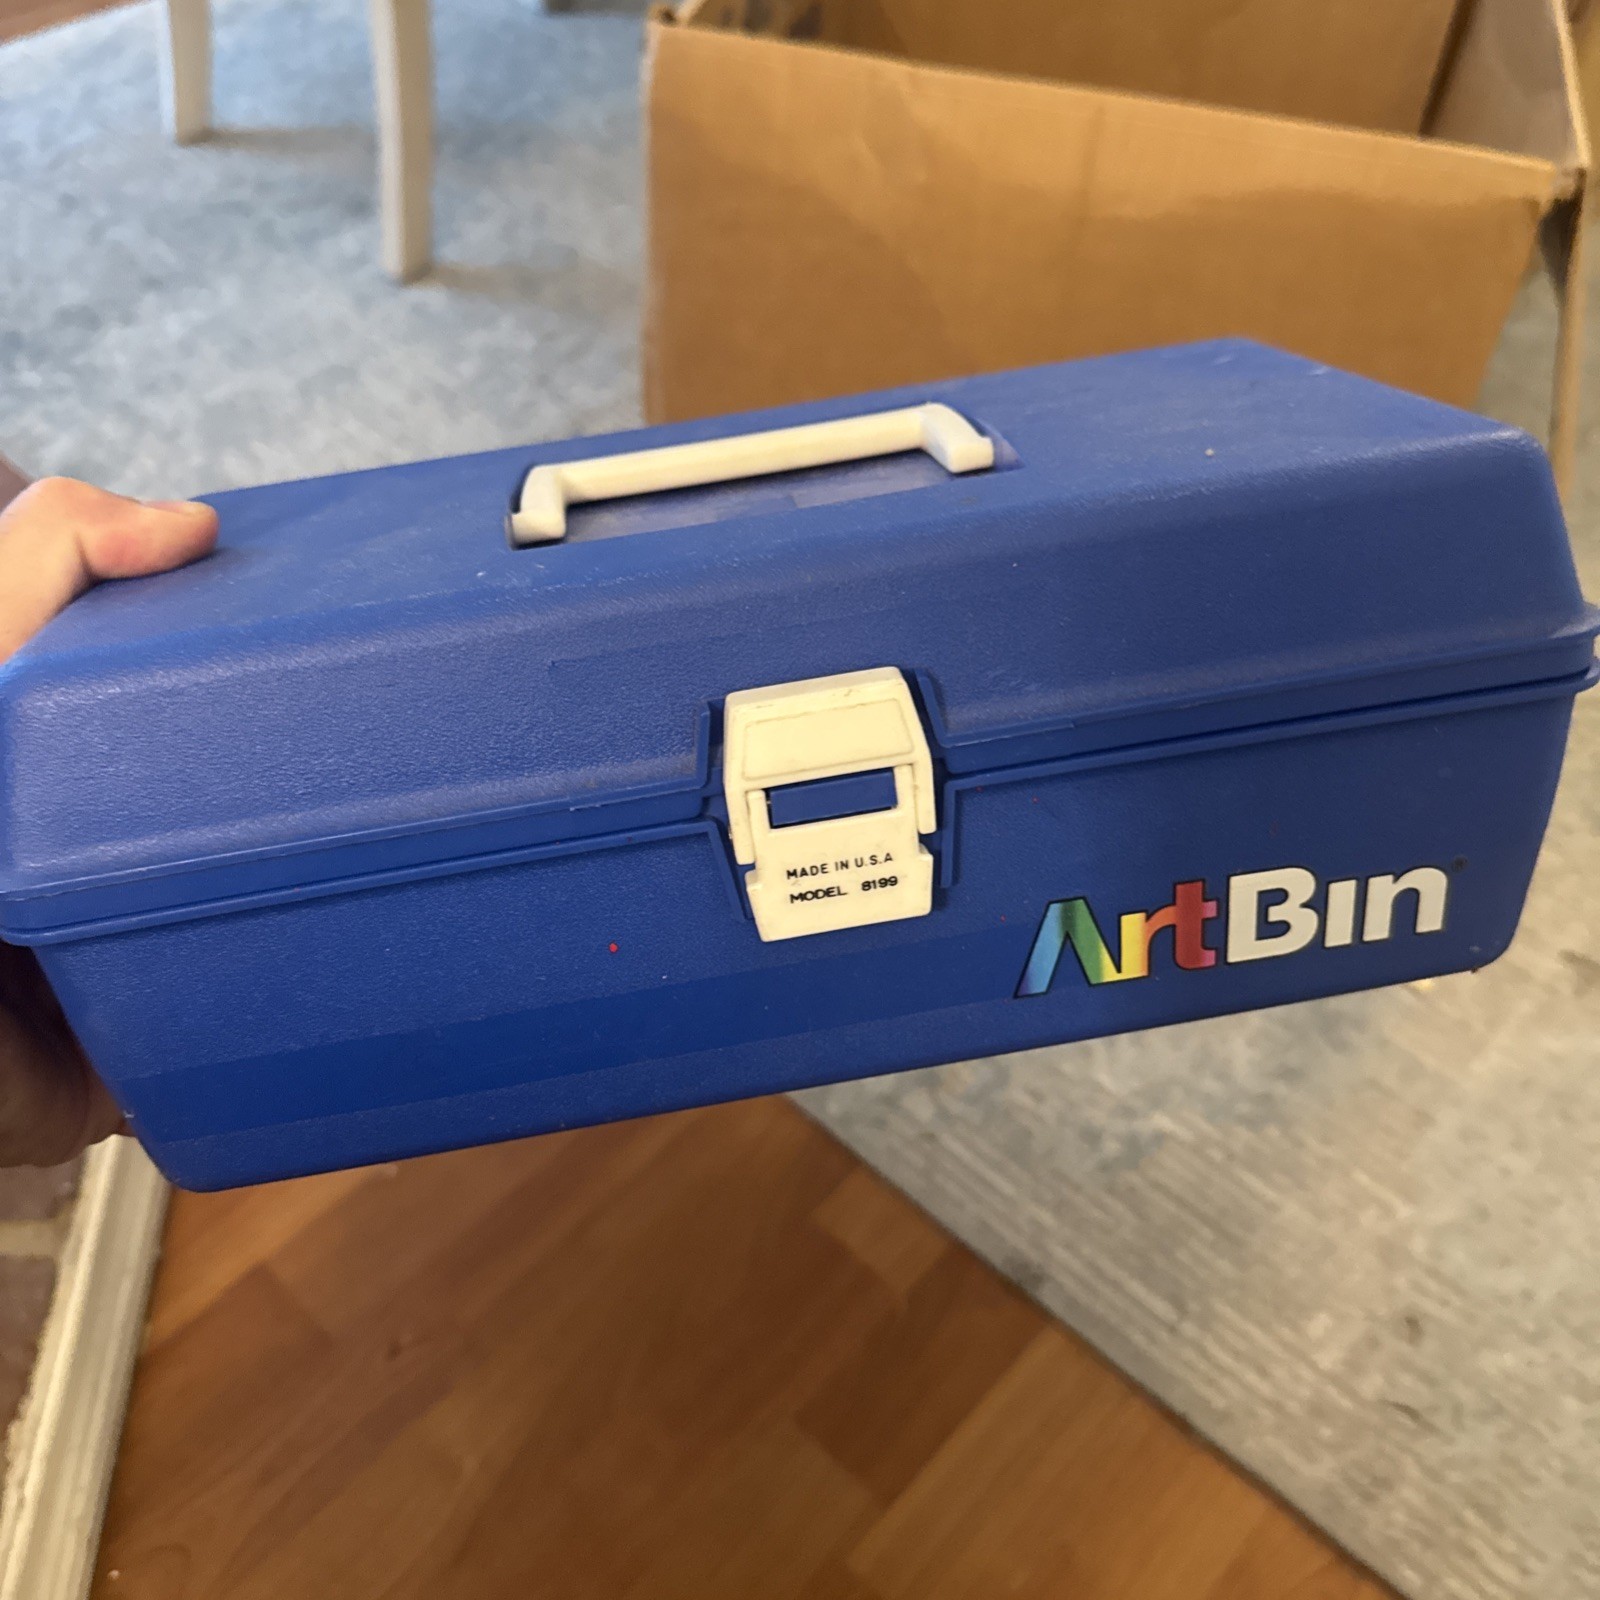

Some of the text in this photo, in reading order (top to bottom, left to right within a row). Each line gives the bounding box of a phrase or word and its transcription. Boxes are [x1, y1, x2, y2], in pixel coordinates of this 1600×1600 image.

[786, 863, 829, 880] MADE
[835, 860, 850, 872] IN
[789, 875, 899, 904] MODEL 8199
[1013, 865, 1449, 998] ArtBin
